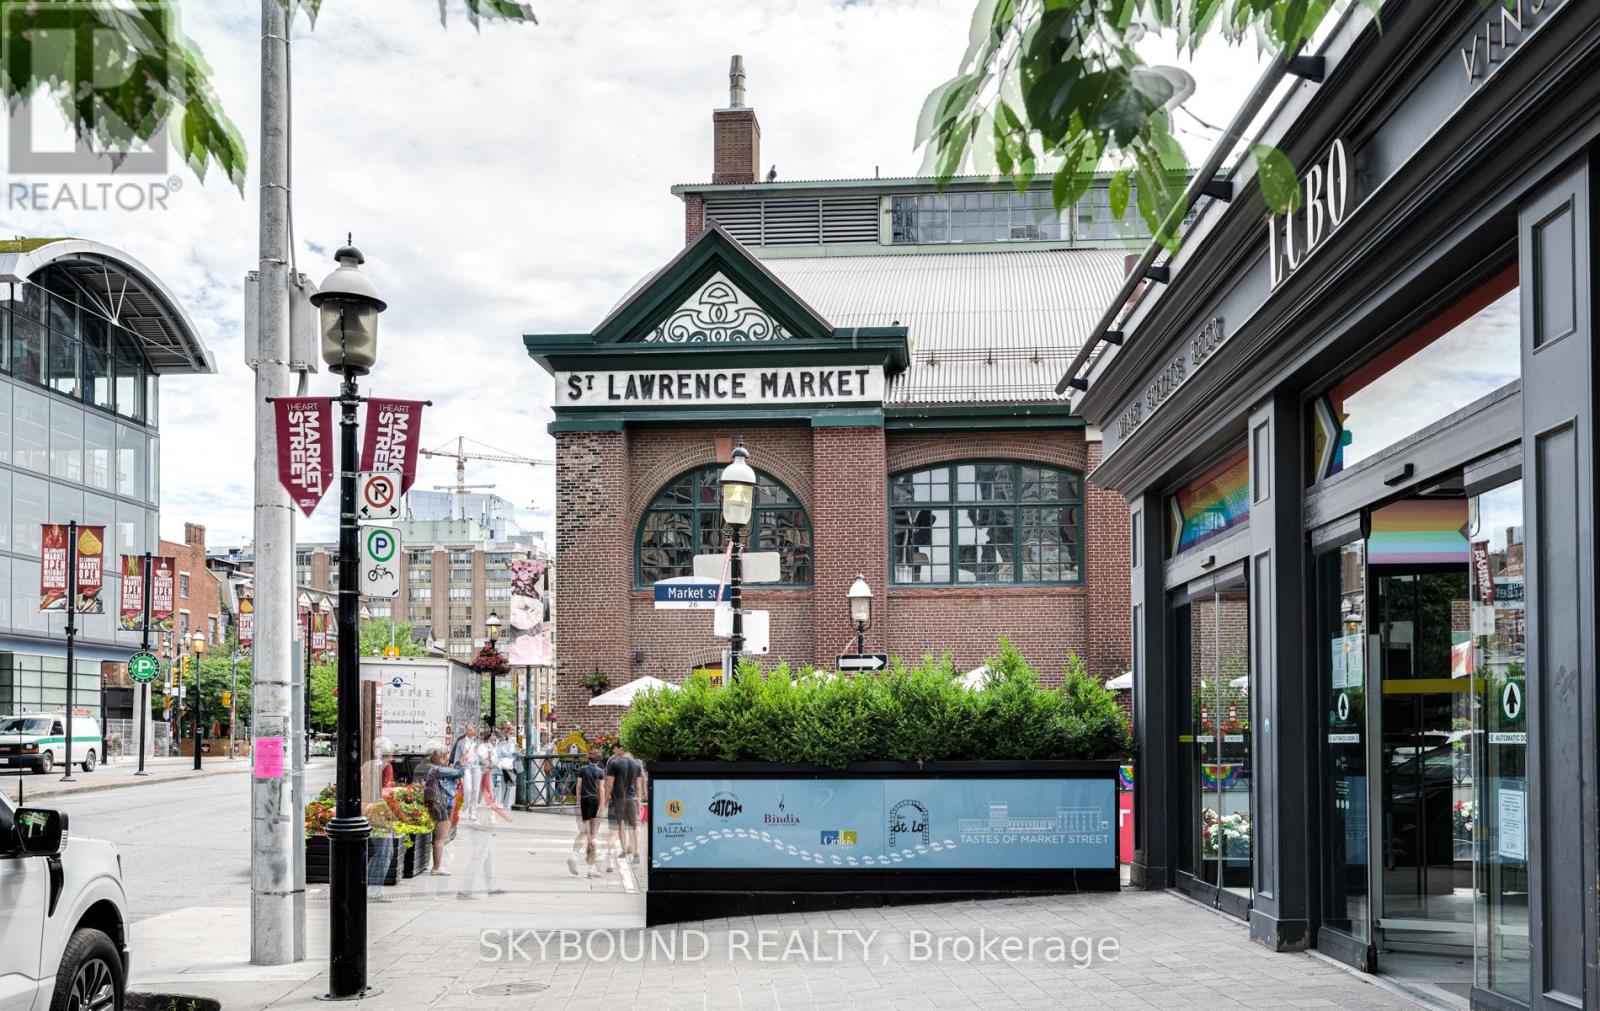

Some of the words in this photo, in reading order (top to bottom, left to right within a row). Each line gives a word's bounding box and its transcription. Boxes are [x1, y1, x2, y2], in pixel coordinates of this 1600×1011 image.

[1268, 138, 1347, 293] LCBO
[1190, 317, 1219, 366] BEER
[608, 373, 746, 400] LAWRENCE
[760, 369, 870, 398] MARKET
[291, 402, 318, 411] HEART
[383, 405, 410, 413] HEART
[373, 411, 393, 472] STREE
[390, 413, 410, 472] MARK
[288, 411, 306, 488] STREET
[304, 411, 322, 496] MARKET
[375, 537, 388, 554] P
[43, 560, 66, 570] OPEN
[79, 569, 100, 579] OPEN
[123, 585, 141, 594] OPEN
[154, 587, 173, 596] OPEN
[668, 587, 704, 599] Market
[708, 589, 717, 599] St
[138, 660, 151, 672] P
[708, 800, 740, 817] CATCH
[960, 834, 1000, 844] TASTES
[1002, 834, 1018, 844] OF
[1020, 834, 1066, 844] MARKET
[1068, 834, 1109, 844] STREET
